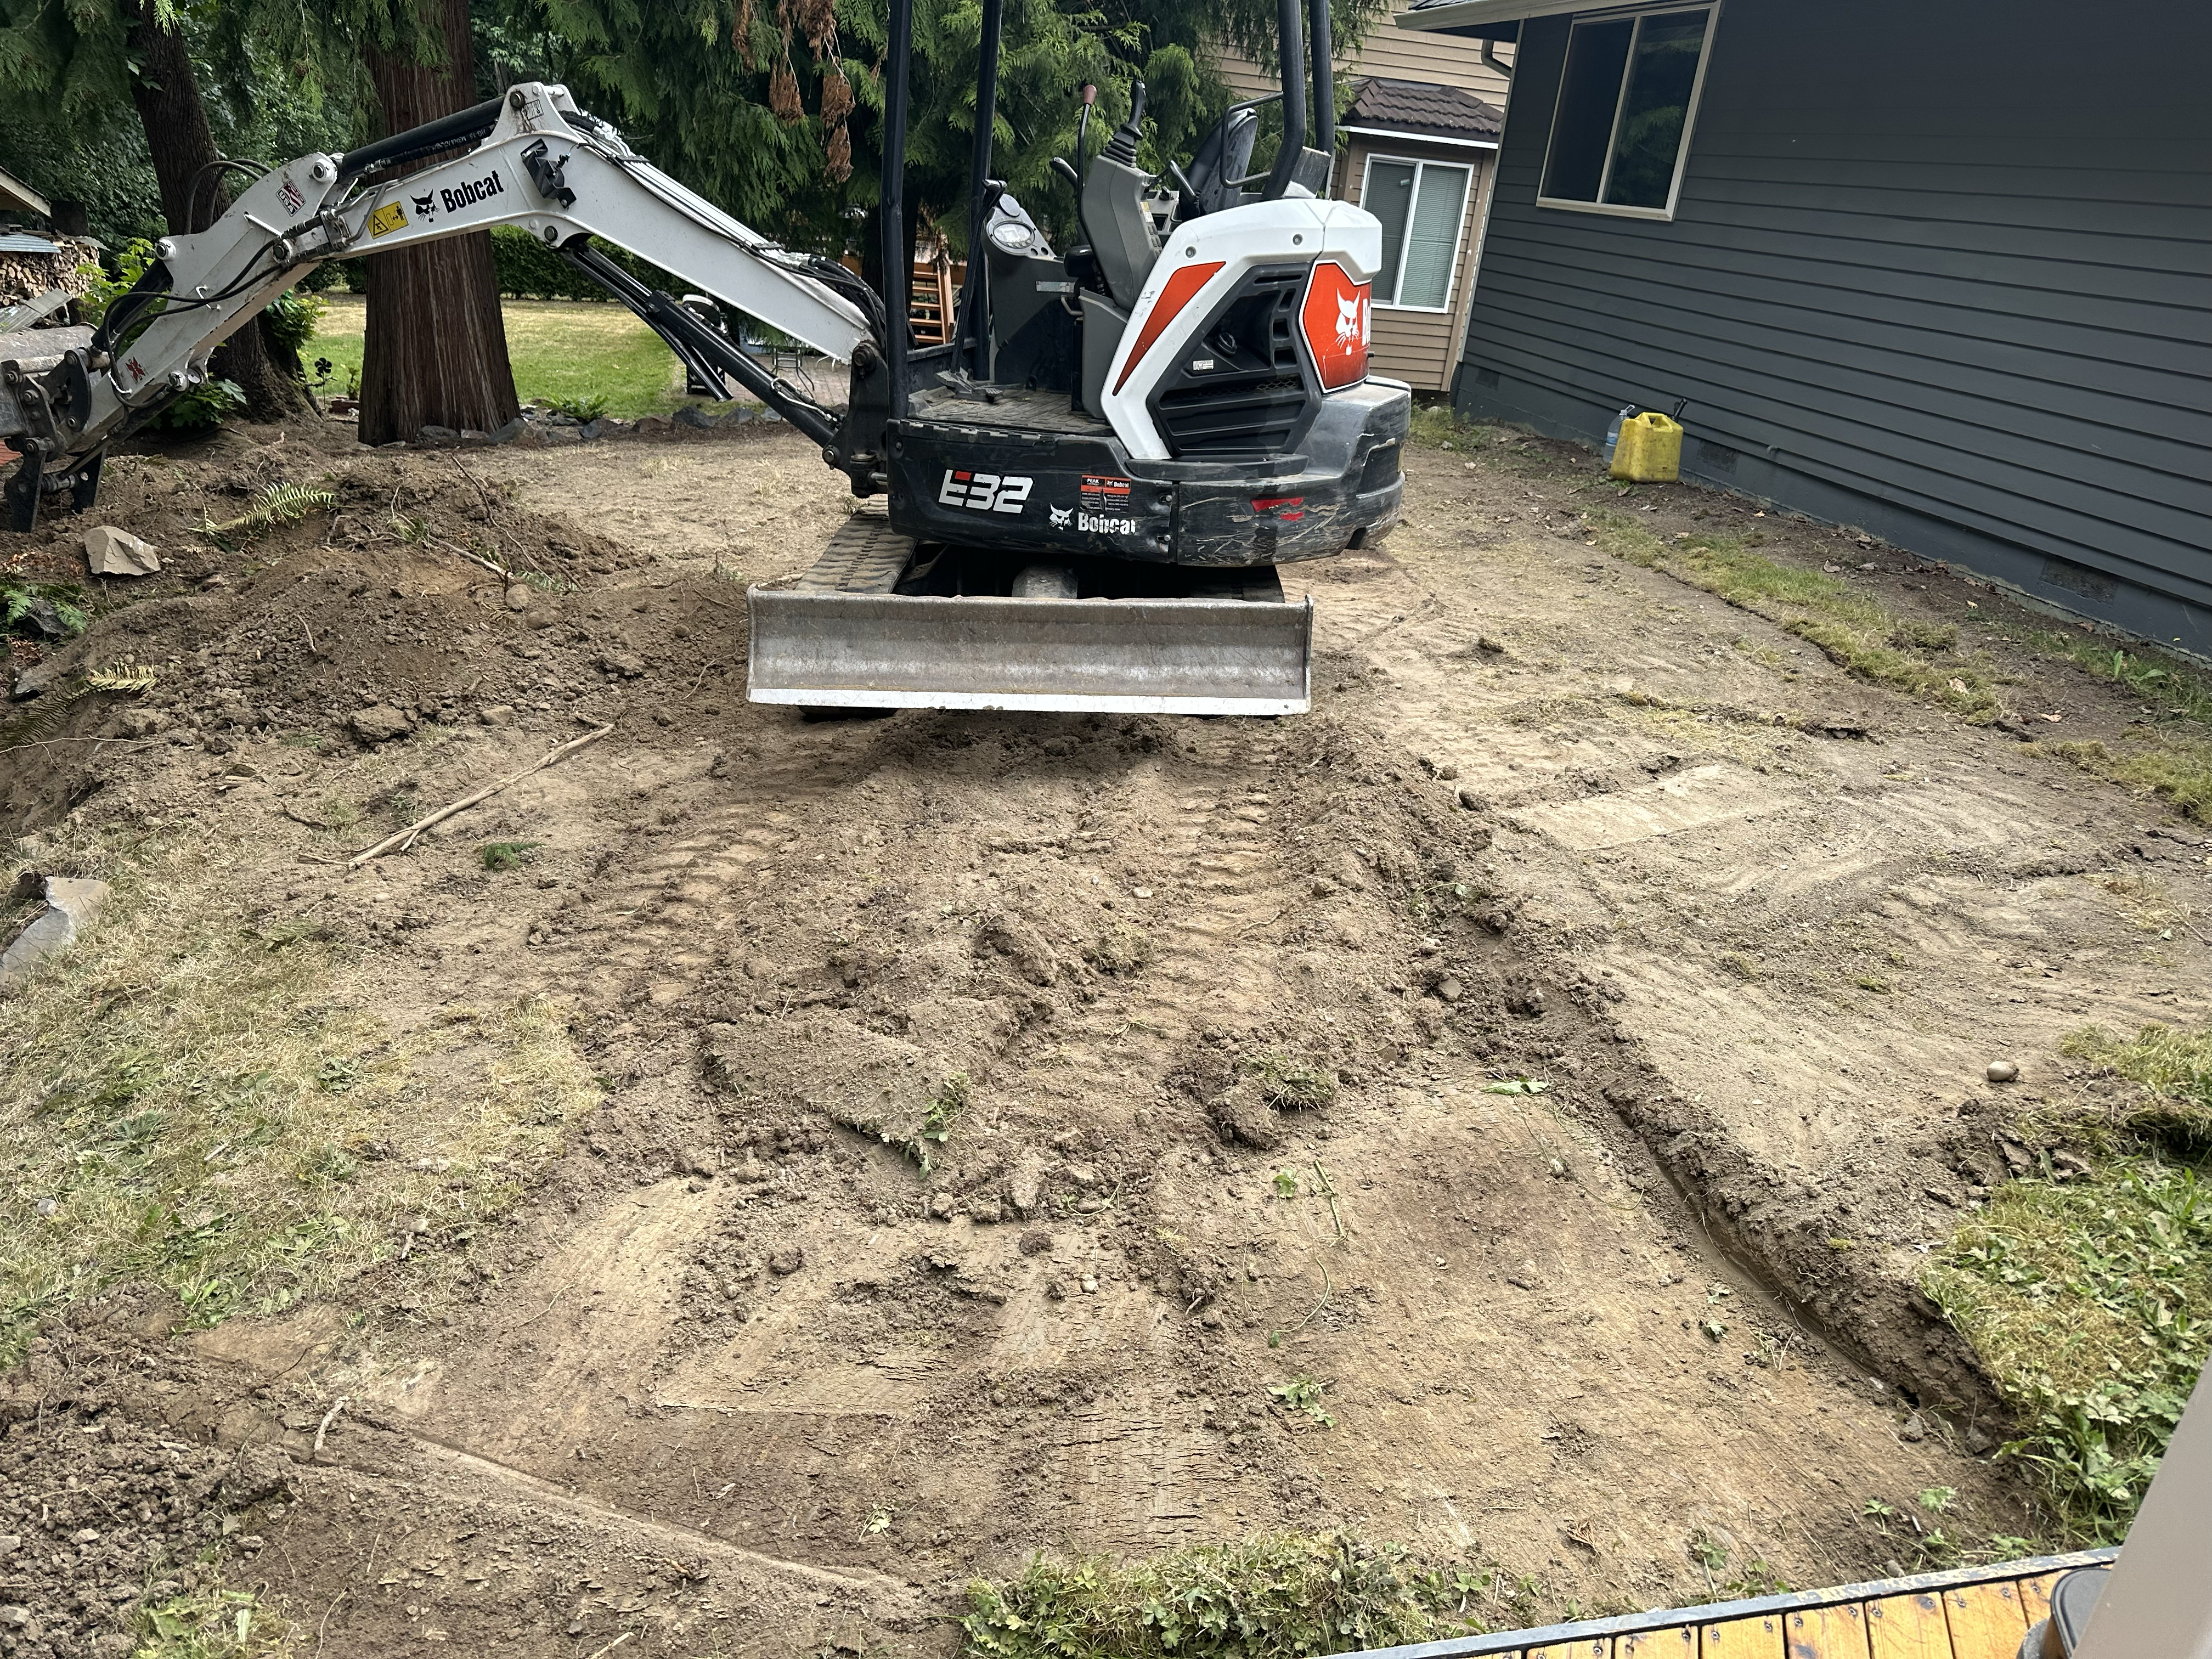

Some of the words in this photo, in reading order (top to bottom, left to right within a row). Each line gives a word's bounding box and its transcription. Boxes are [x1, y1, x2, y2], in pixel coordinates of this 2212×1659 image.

[278, 190, 294, 213] USA
[439, 170, 504, 213] Bobcat
[939, 469, 1034, 514] E32
[1078, 512, 1136, 535] Bobcat
